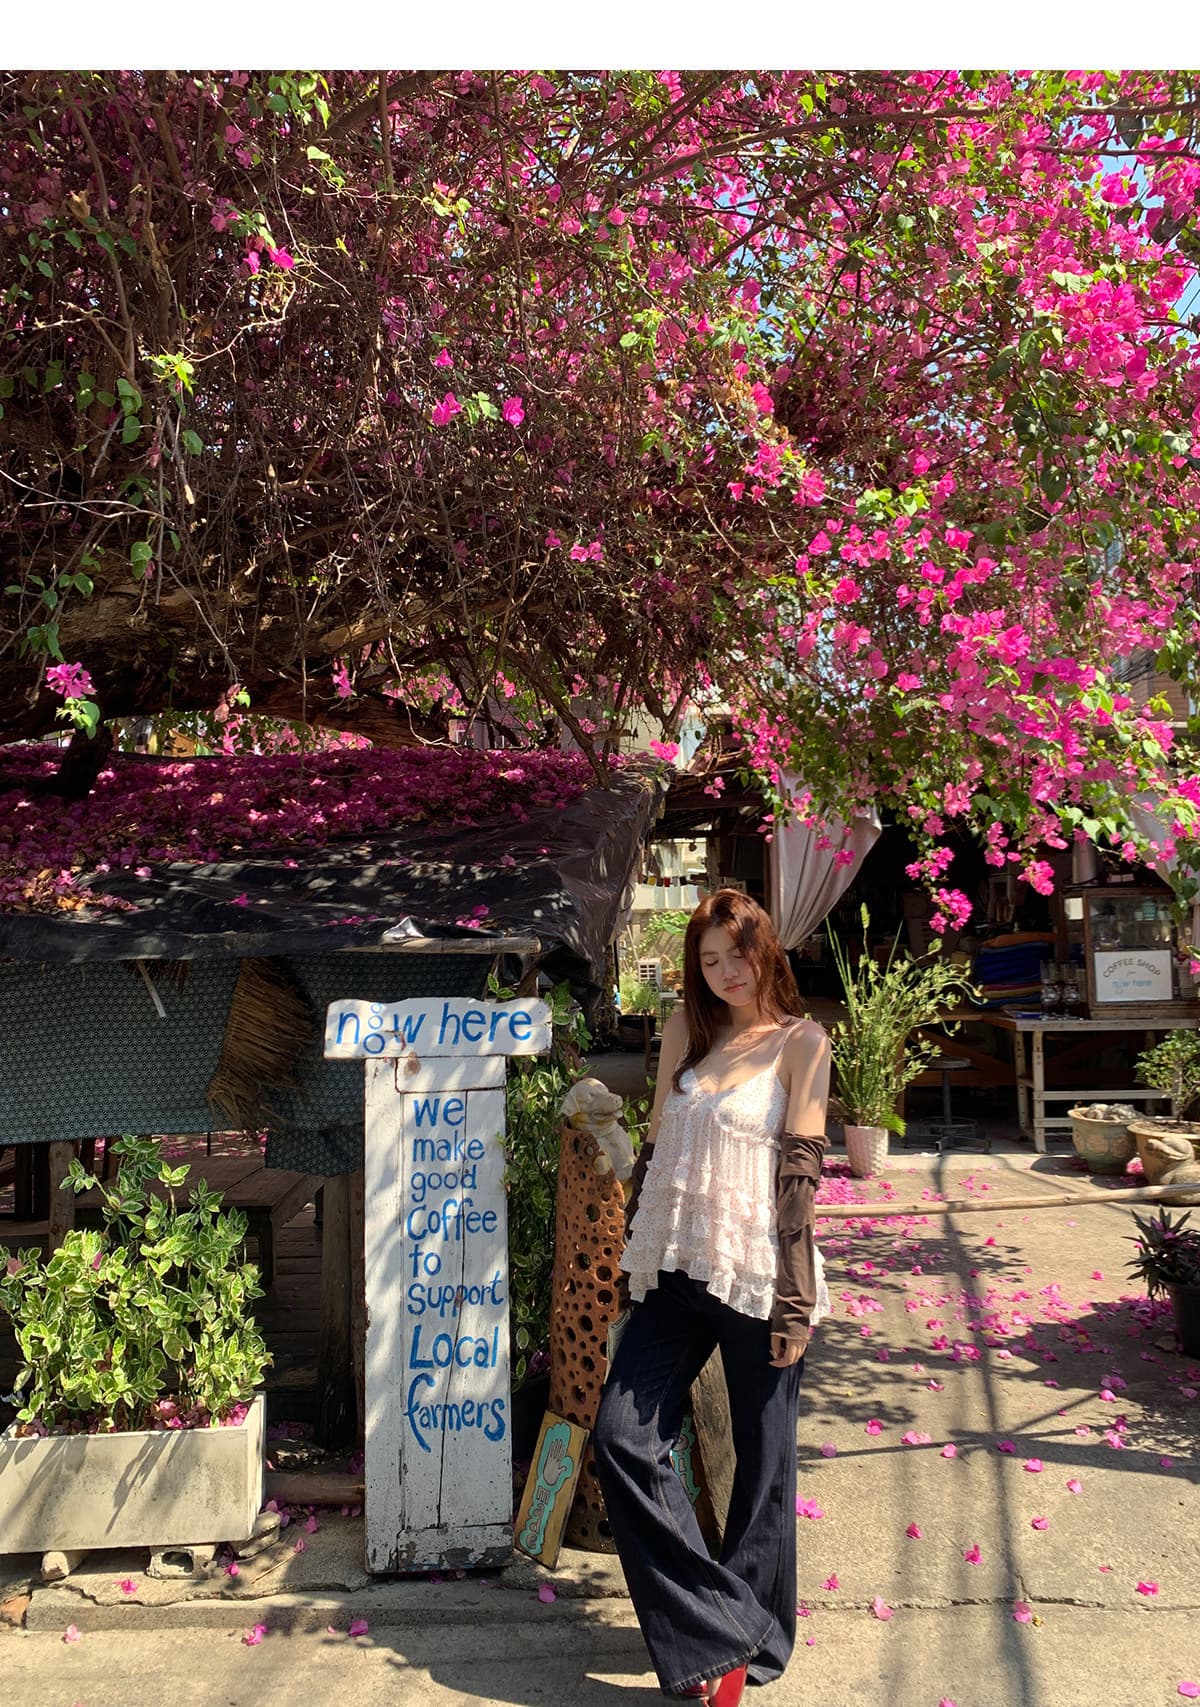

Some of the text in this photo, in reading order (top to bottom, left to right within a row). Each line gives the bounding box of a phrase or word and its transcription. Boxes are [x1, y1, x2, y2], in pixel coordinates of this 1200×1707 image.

[1103, 958, 1161, 978] COFFEE SHOP
[438, 1002, 533, 1045] here
[413, 1097, 465, 1127] we
[412, 1131, 485, 1162] make
[410, 1165, 477, 1202] good
[407, 1198, 498, 1241] Coffee
[409, 1244, 442, 1278] to
[409, 1324, 499, 1370] Local
